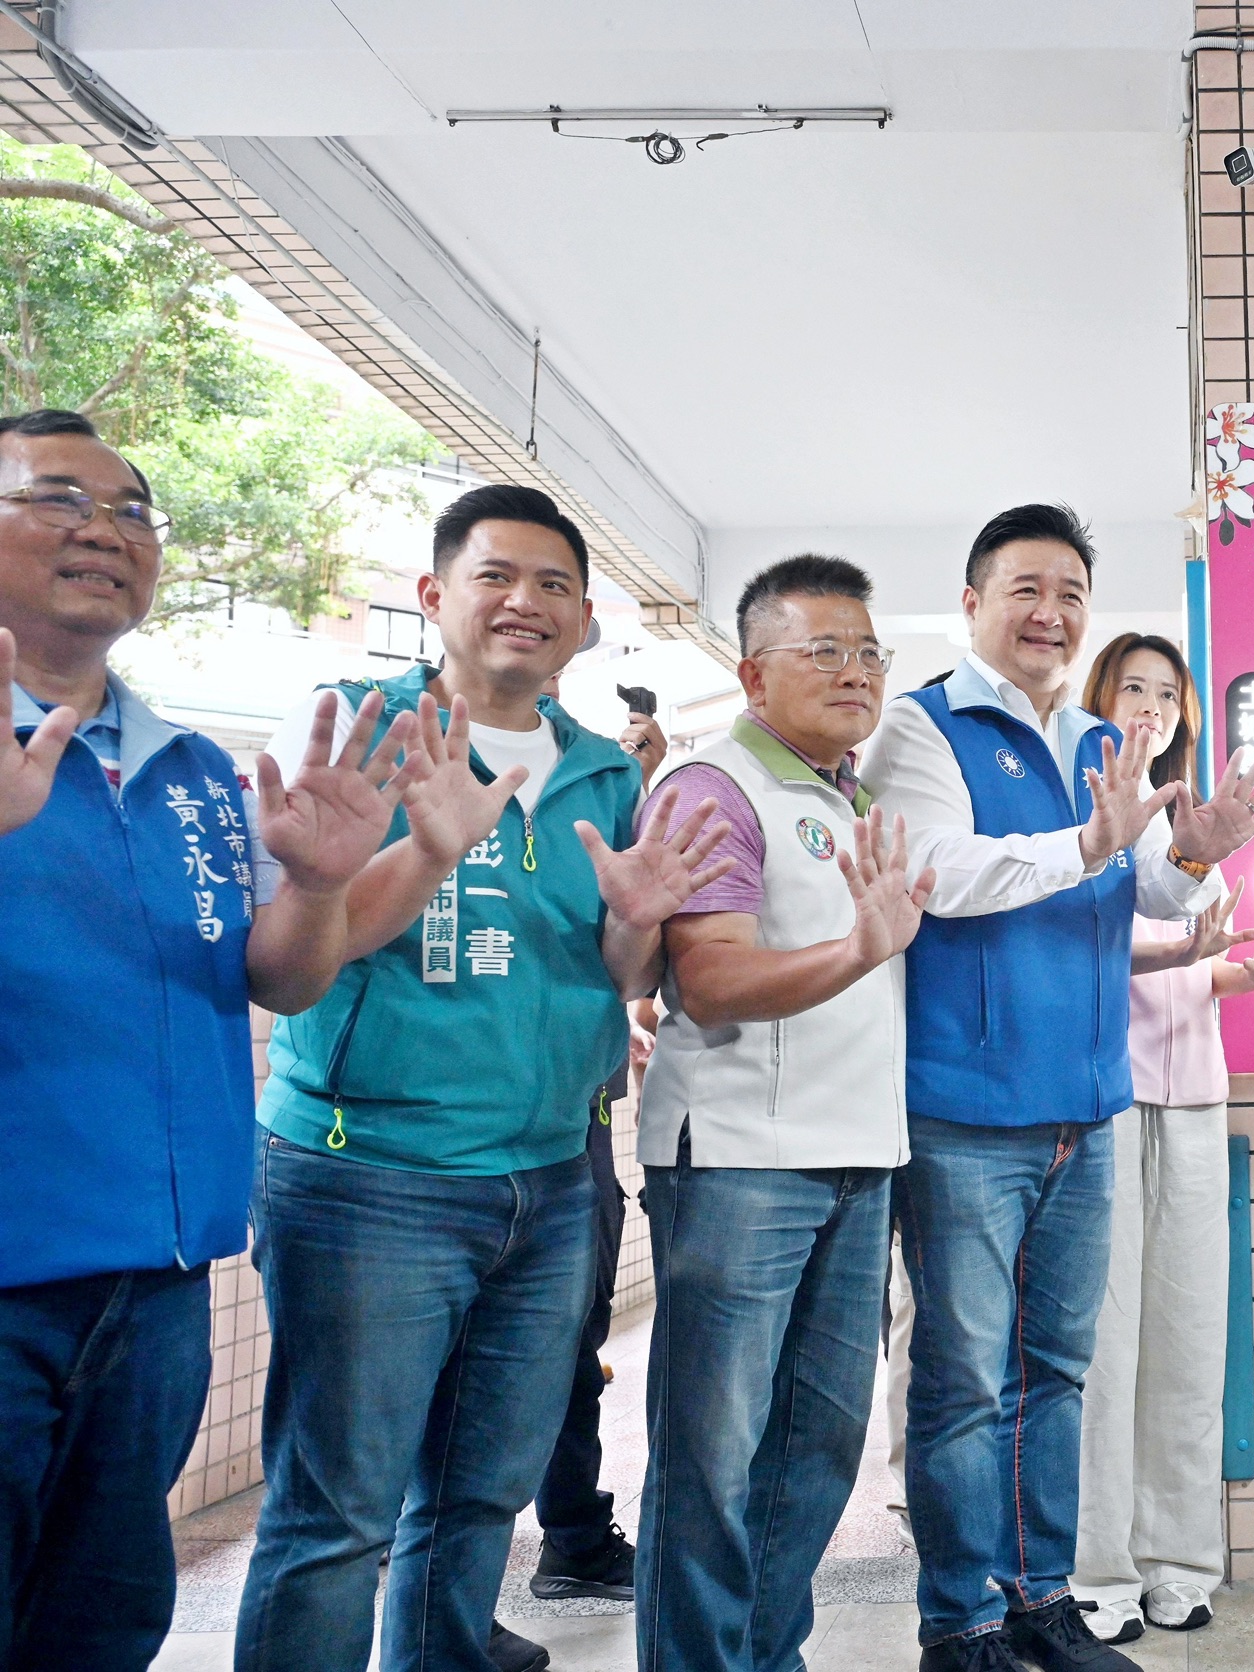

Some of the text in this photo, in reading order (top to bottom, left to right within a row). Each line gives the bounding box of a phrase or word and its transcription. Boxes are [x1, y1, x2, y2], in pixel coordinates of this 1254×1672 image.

[166, 783, 229, 943] 黃永昌
[204, 775, 253, 923] 新北市議員
[426, 872, 454, 973] 市議員
[464, 828, 515, 976] 彭一書
